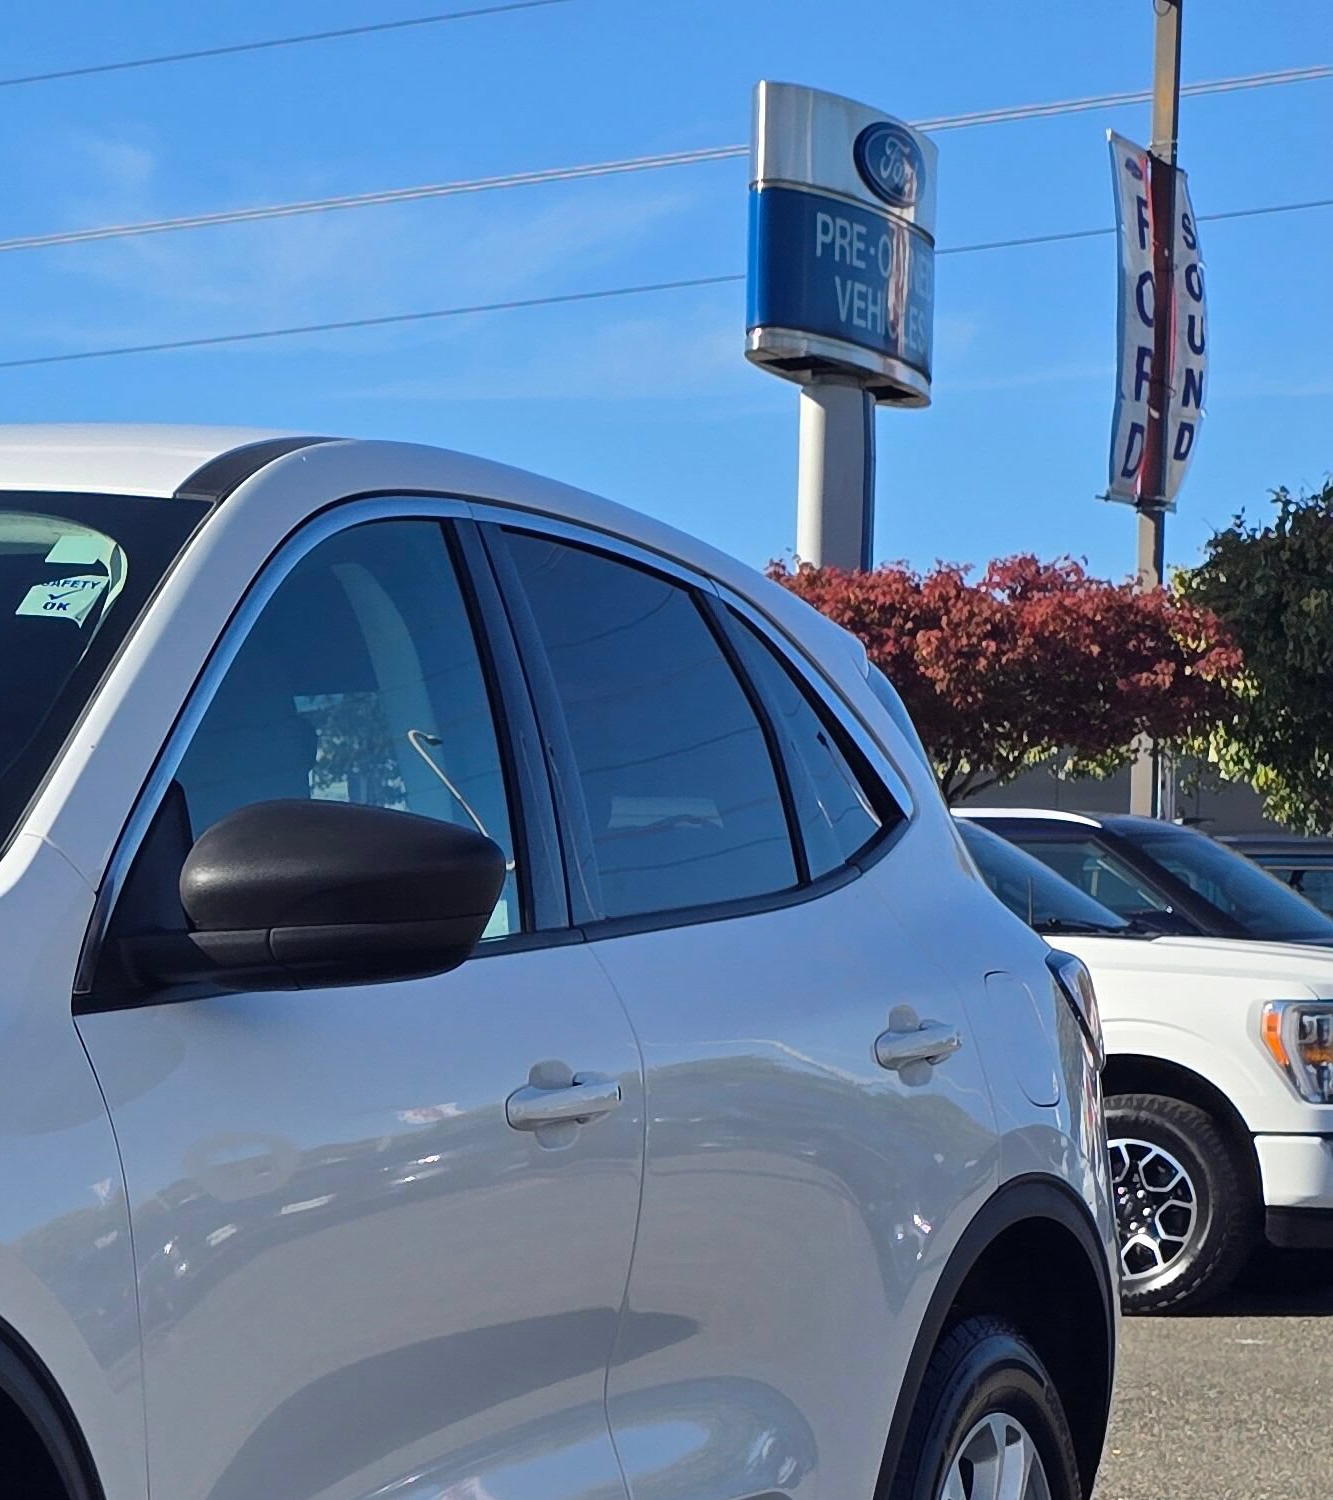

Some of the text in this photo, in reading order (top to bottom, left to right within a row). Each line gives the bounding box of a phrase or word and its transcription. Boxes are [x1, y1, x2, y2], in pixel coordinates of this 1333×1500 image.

[835, 275, 926, 355] VEHIES
[1173, 213, 1206, 461] SOUND
[42, 601, 71, 611] OK
